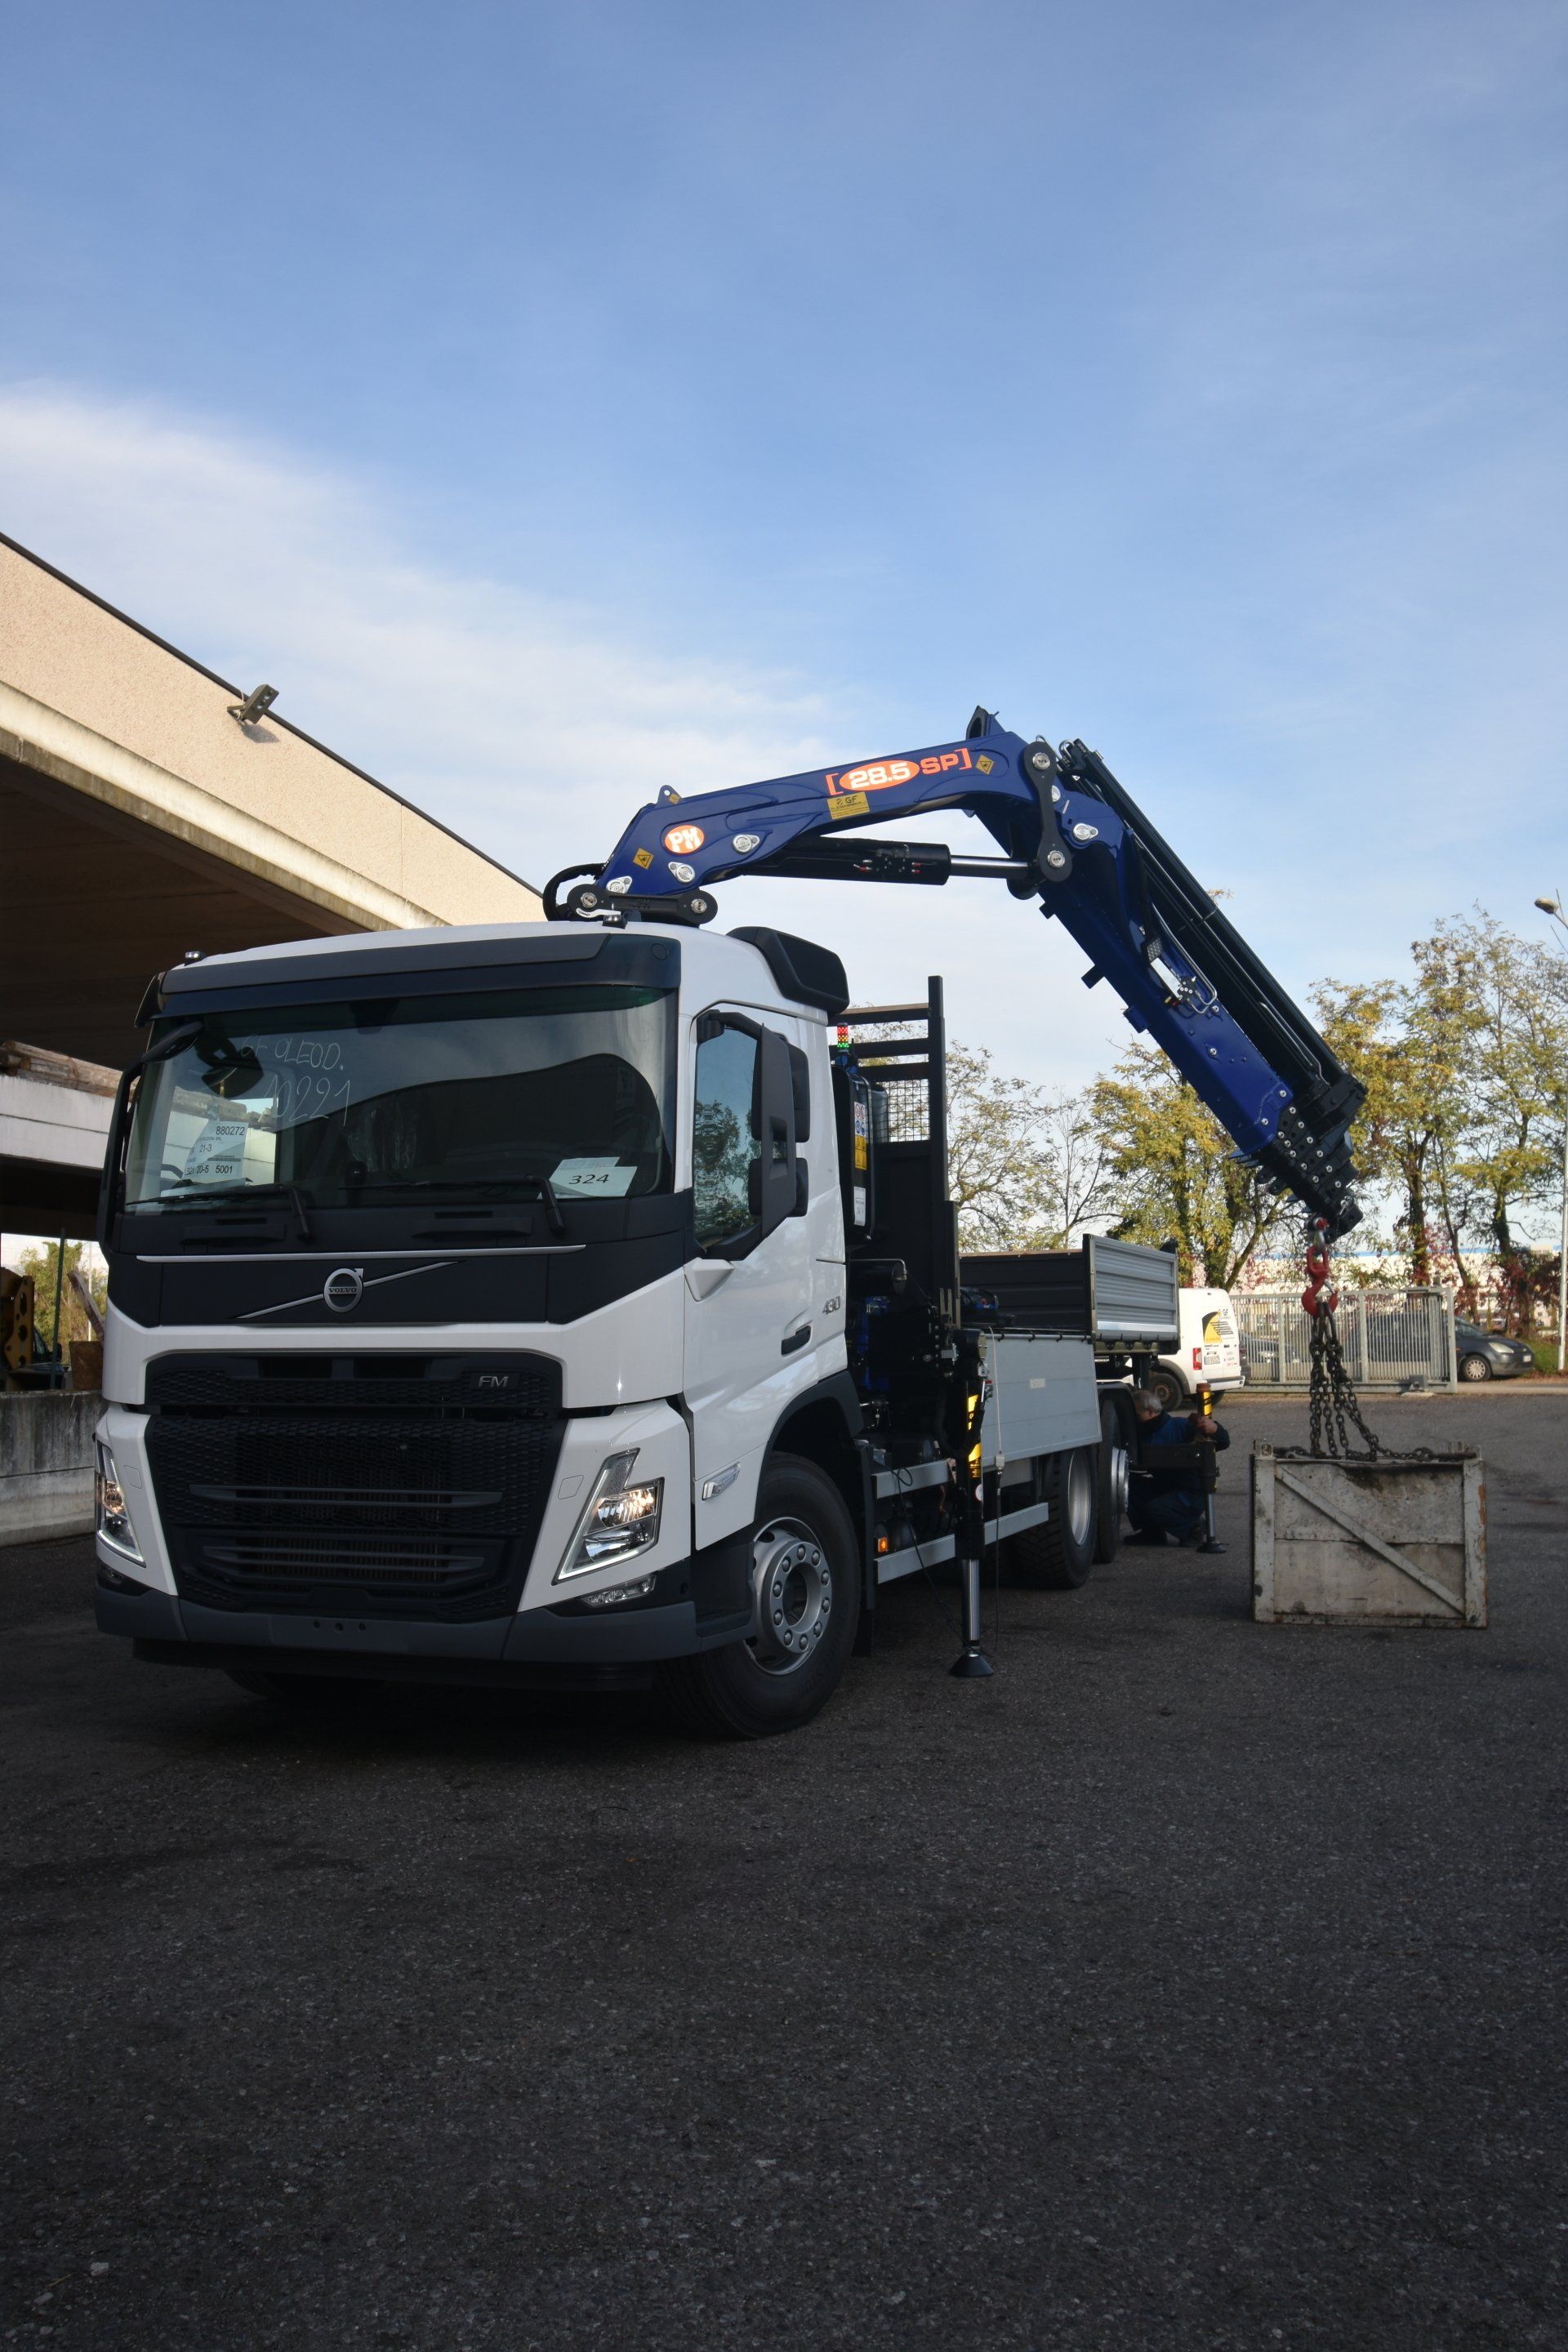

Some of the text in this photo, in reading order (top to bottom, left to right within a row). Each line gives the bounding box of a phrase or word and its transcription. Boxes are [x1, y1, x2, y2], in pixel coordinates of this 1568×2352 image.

[844, 795, 858, 804] GF
[667, 827, 702, 852] PM
[216, 1126, 245, 1135] 880272
[199, 1144, 212, 1152] 21-3
[196, 1165, 209, 1174] 20-5
[215, 1165, 233, 1174] 5001
[568, 1174, 609, 1185] 324
[822, 1295, 840, 1315] 430
[478, 1375, 508, 1388] FM
